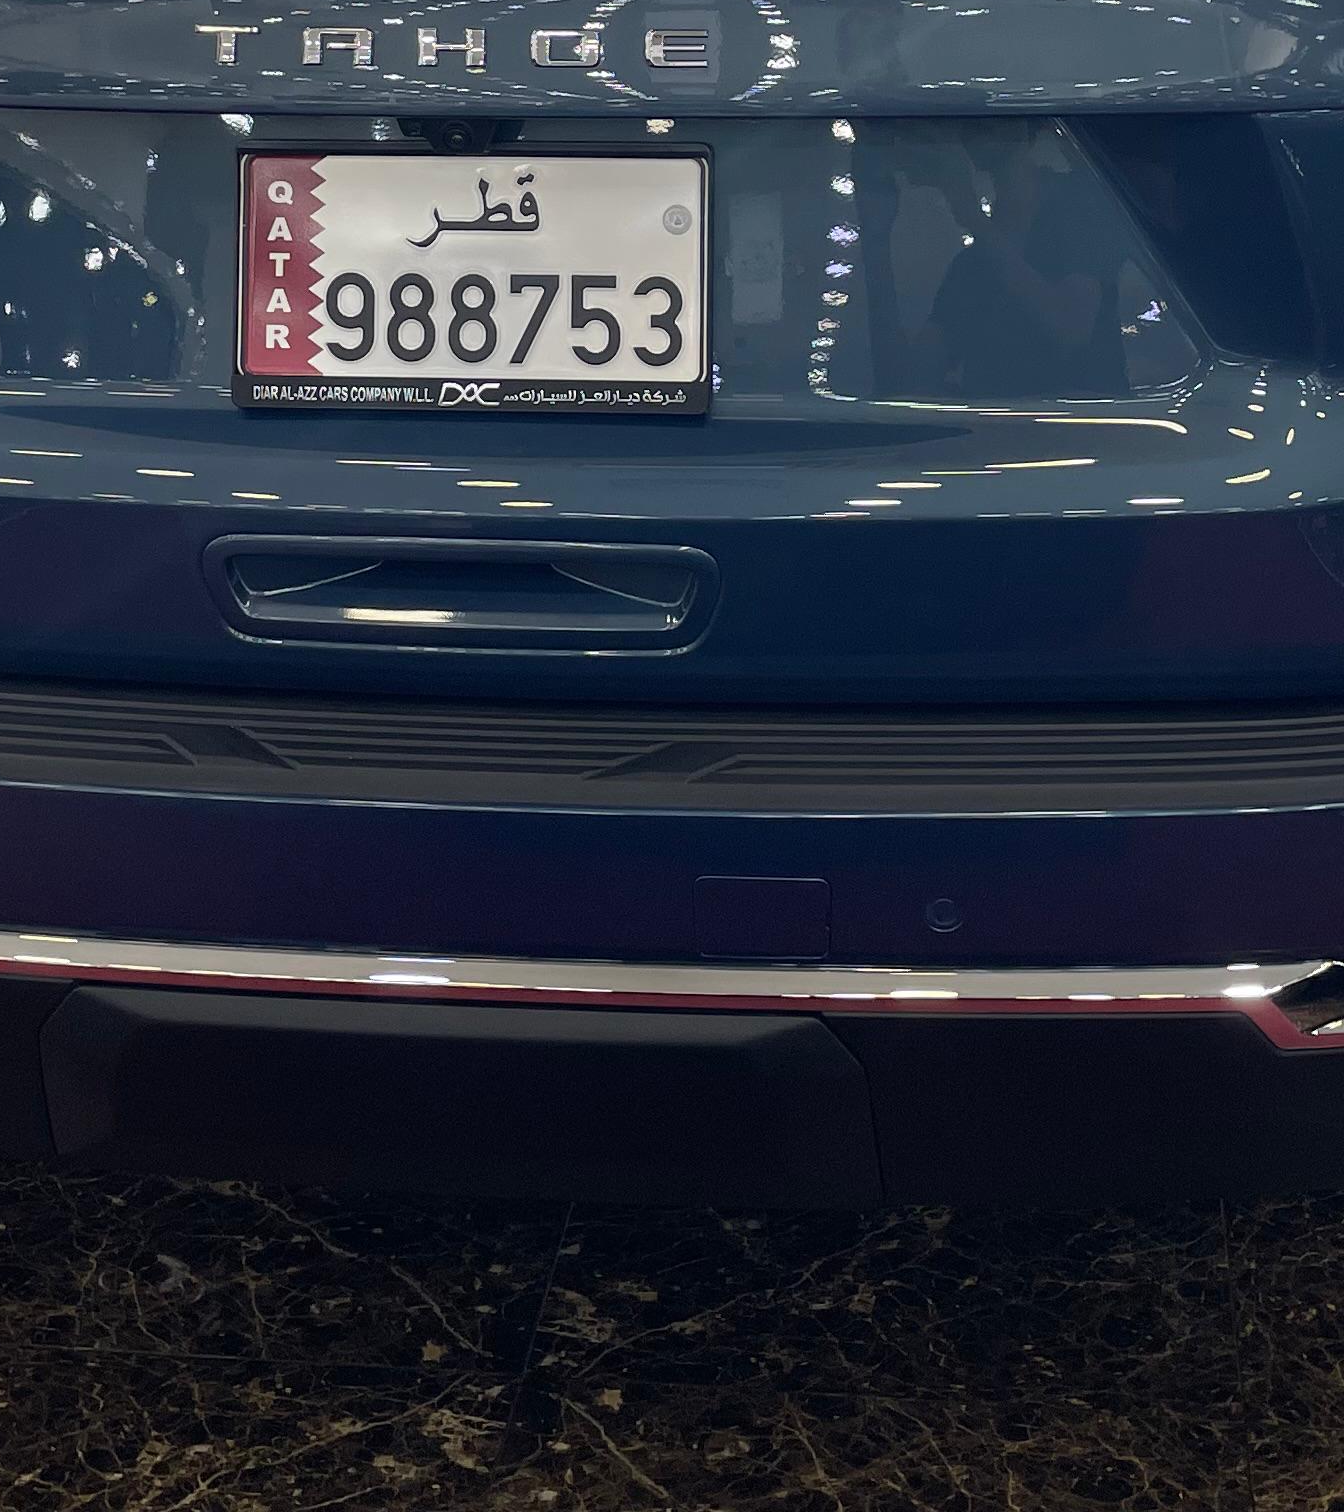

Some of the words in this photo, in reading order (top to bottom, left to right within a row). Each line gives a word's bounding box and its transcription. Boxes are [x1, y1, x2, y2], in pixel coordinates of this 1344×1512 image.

[195, 24, 710, 68] TAHOE
[407, 172, 539, 248] قطر
[265, 180, 293, 350] QATAR
[325, 272, 683, 367] 988753
[253, 386, 278, 400] DIAR
[319, 387, 348, 402] CARS
[350, 387, 402, 402] COMPANY
[518, 389, 577, 406] للسيارات
[642, 389, 686, 406] شركة
